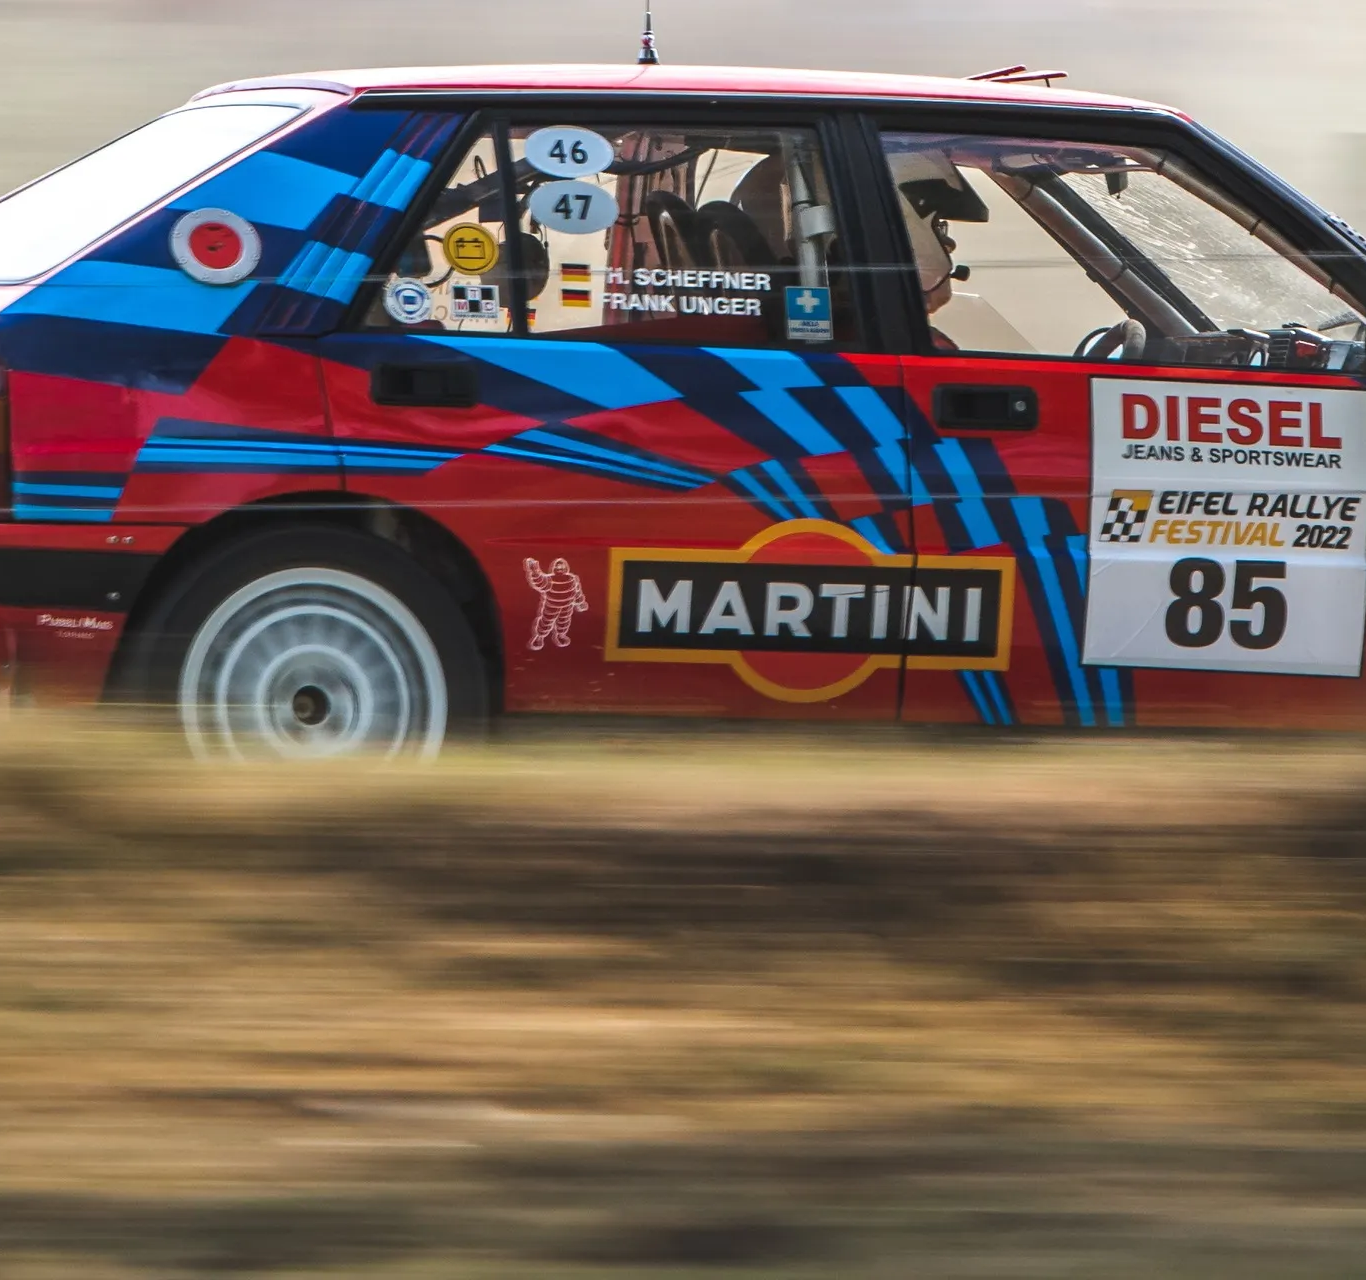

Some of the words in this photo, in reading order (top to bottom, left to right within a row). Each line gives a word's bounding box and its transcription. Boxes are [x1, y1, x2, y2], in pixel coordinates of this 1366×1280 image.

[549, 139, 588, 164] 46
[554, 194, 592, 220] 47
[607, 267, 629, 285] H.
[634, 268, 771, 291] SCHEFFNER
[602, 292, 676, 313] FRANK
[679, 295, 761, 316] UNGER
[1121, 393, 1342, 449] DIESEL
[1121, 443, 1185, 462] JEANS
[1190, 447, 1204, 463] &
[1209, 449, 1342, 469] SPORTSWEAR
[1158, 490, 1238, 516] EIFEL
[1246, 492, 1362, 522] RALLYE
[1148, 519, 1285, 547] FESTIVAL
[1292, 523, 1353, 550] 2022
[636, 578, 983, 642] MARTINI
[1165, 557, 1288, 650] 85
